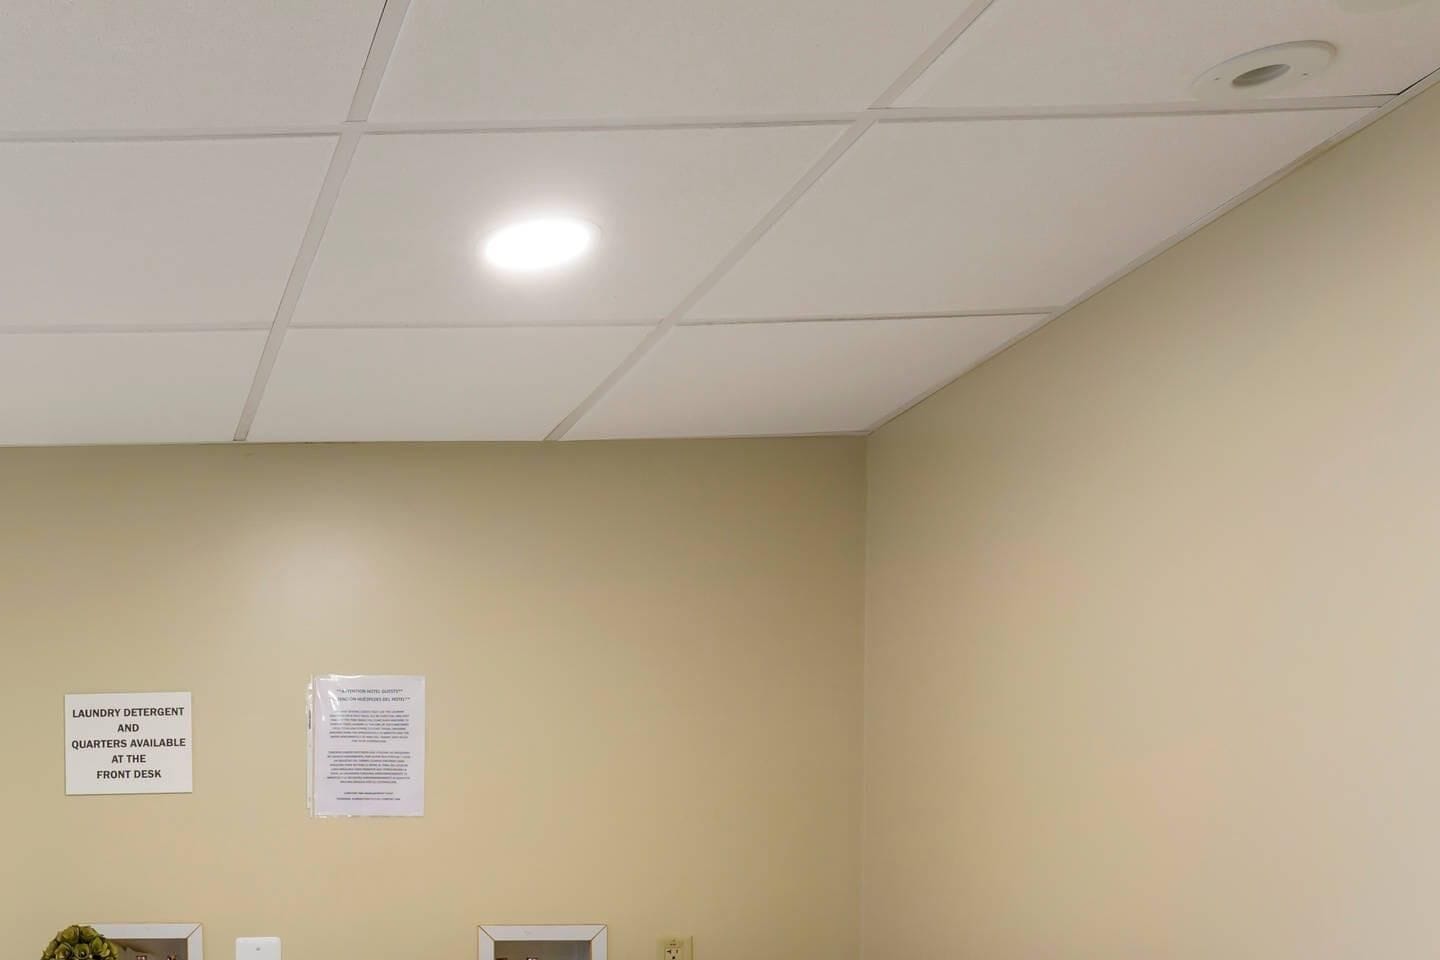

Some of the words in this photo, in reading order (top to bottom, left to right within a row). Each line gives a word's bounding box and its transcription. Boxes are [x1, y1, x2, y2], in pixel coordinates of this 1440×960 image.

[72, 708, 120, 718] LAUNDRY
[123, 706, 184, 717] DETERGENT
[117, 723, 140, 733] AND
[71, 739, 127, 750] QUARTERS
[130, 738, 186, 748] AVAILABLE
[111, 755, 123, 763] AT
[126, 754, 147, 763] THE
[96, 770, 131, 779] FRONT
[134, 769, 162, 779] DESK
